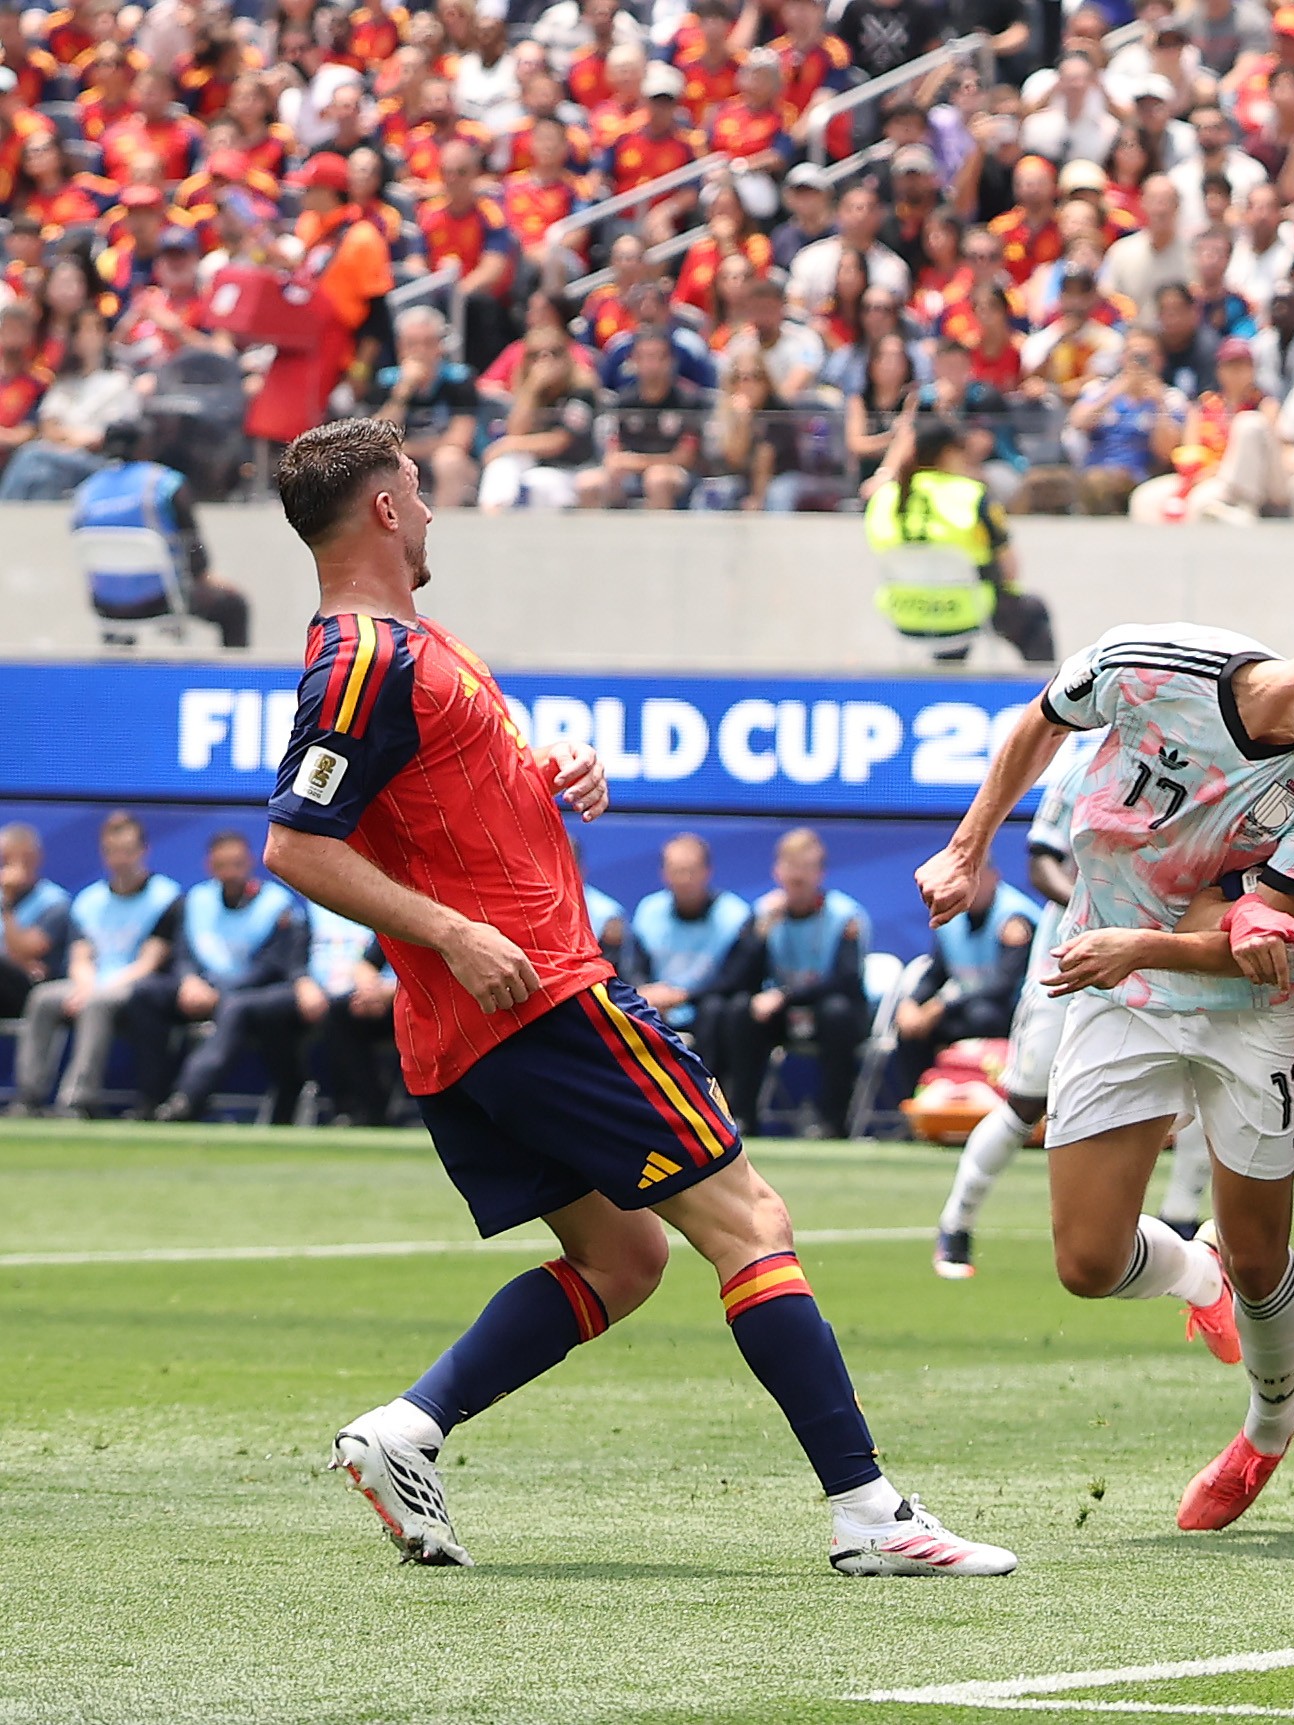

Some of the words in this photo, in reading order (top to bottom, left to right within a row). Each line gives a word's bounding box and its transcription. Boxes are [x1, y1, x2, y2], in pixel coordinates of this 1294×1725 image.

[178, 688, 299, 773] FIF
[503, 694, 709, 782] RLD
[717, 698, 903, 784] CUP
[1123, 760, 1188, 830] 17
